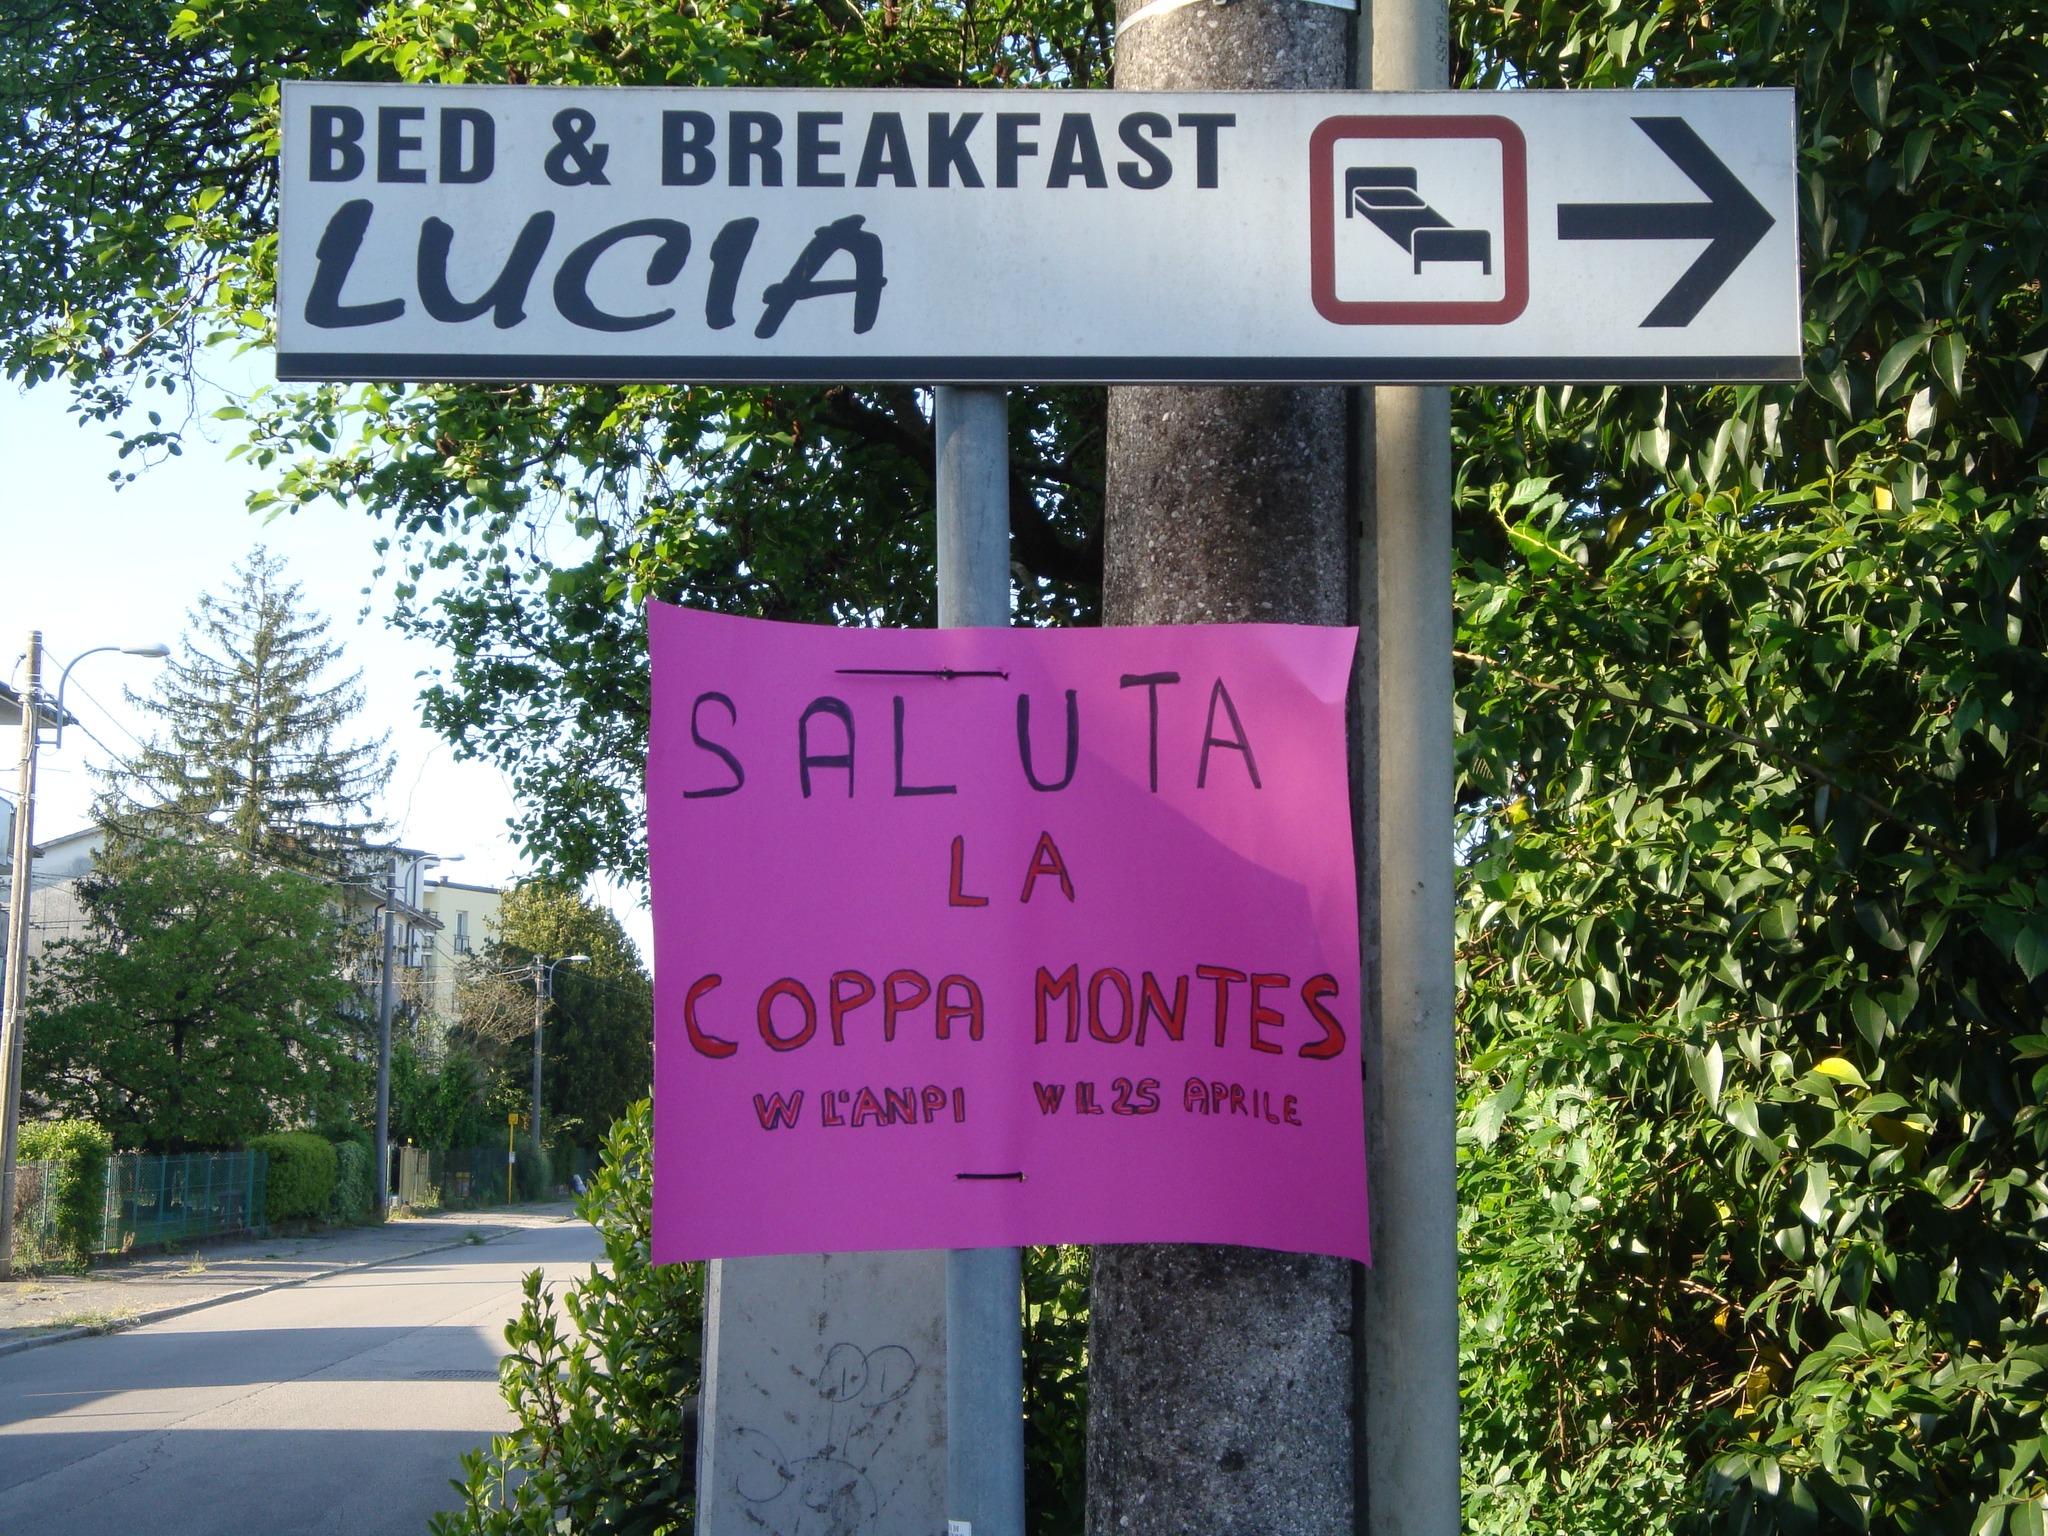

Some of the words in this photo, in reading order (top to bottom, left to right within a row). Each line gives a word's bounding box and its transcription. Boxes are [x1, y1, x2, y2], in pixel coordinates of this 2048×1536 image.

[309, 105, 496, 184] BED
[544, 107, 612, 187] &
[661, 110, 1236, 190] BREAKFAST
[304, 198, 888, 340] LUCIA
[683, 671, 1262, 800] SALUTA
[948, 830, 1076, 908] LA
[683, 968, 985, 1060] COPPA
[1034, 962, 1347, 1061] MONTES
[752, 1089, 805, 1132] W
[820, 1084, 966, 1128] L'ANPI
[1032, 1081, 1066, 1116] W
[1183, 1076, 1303, 1127] APRILE
